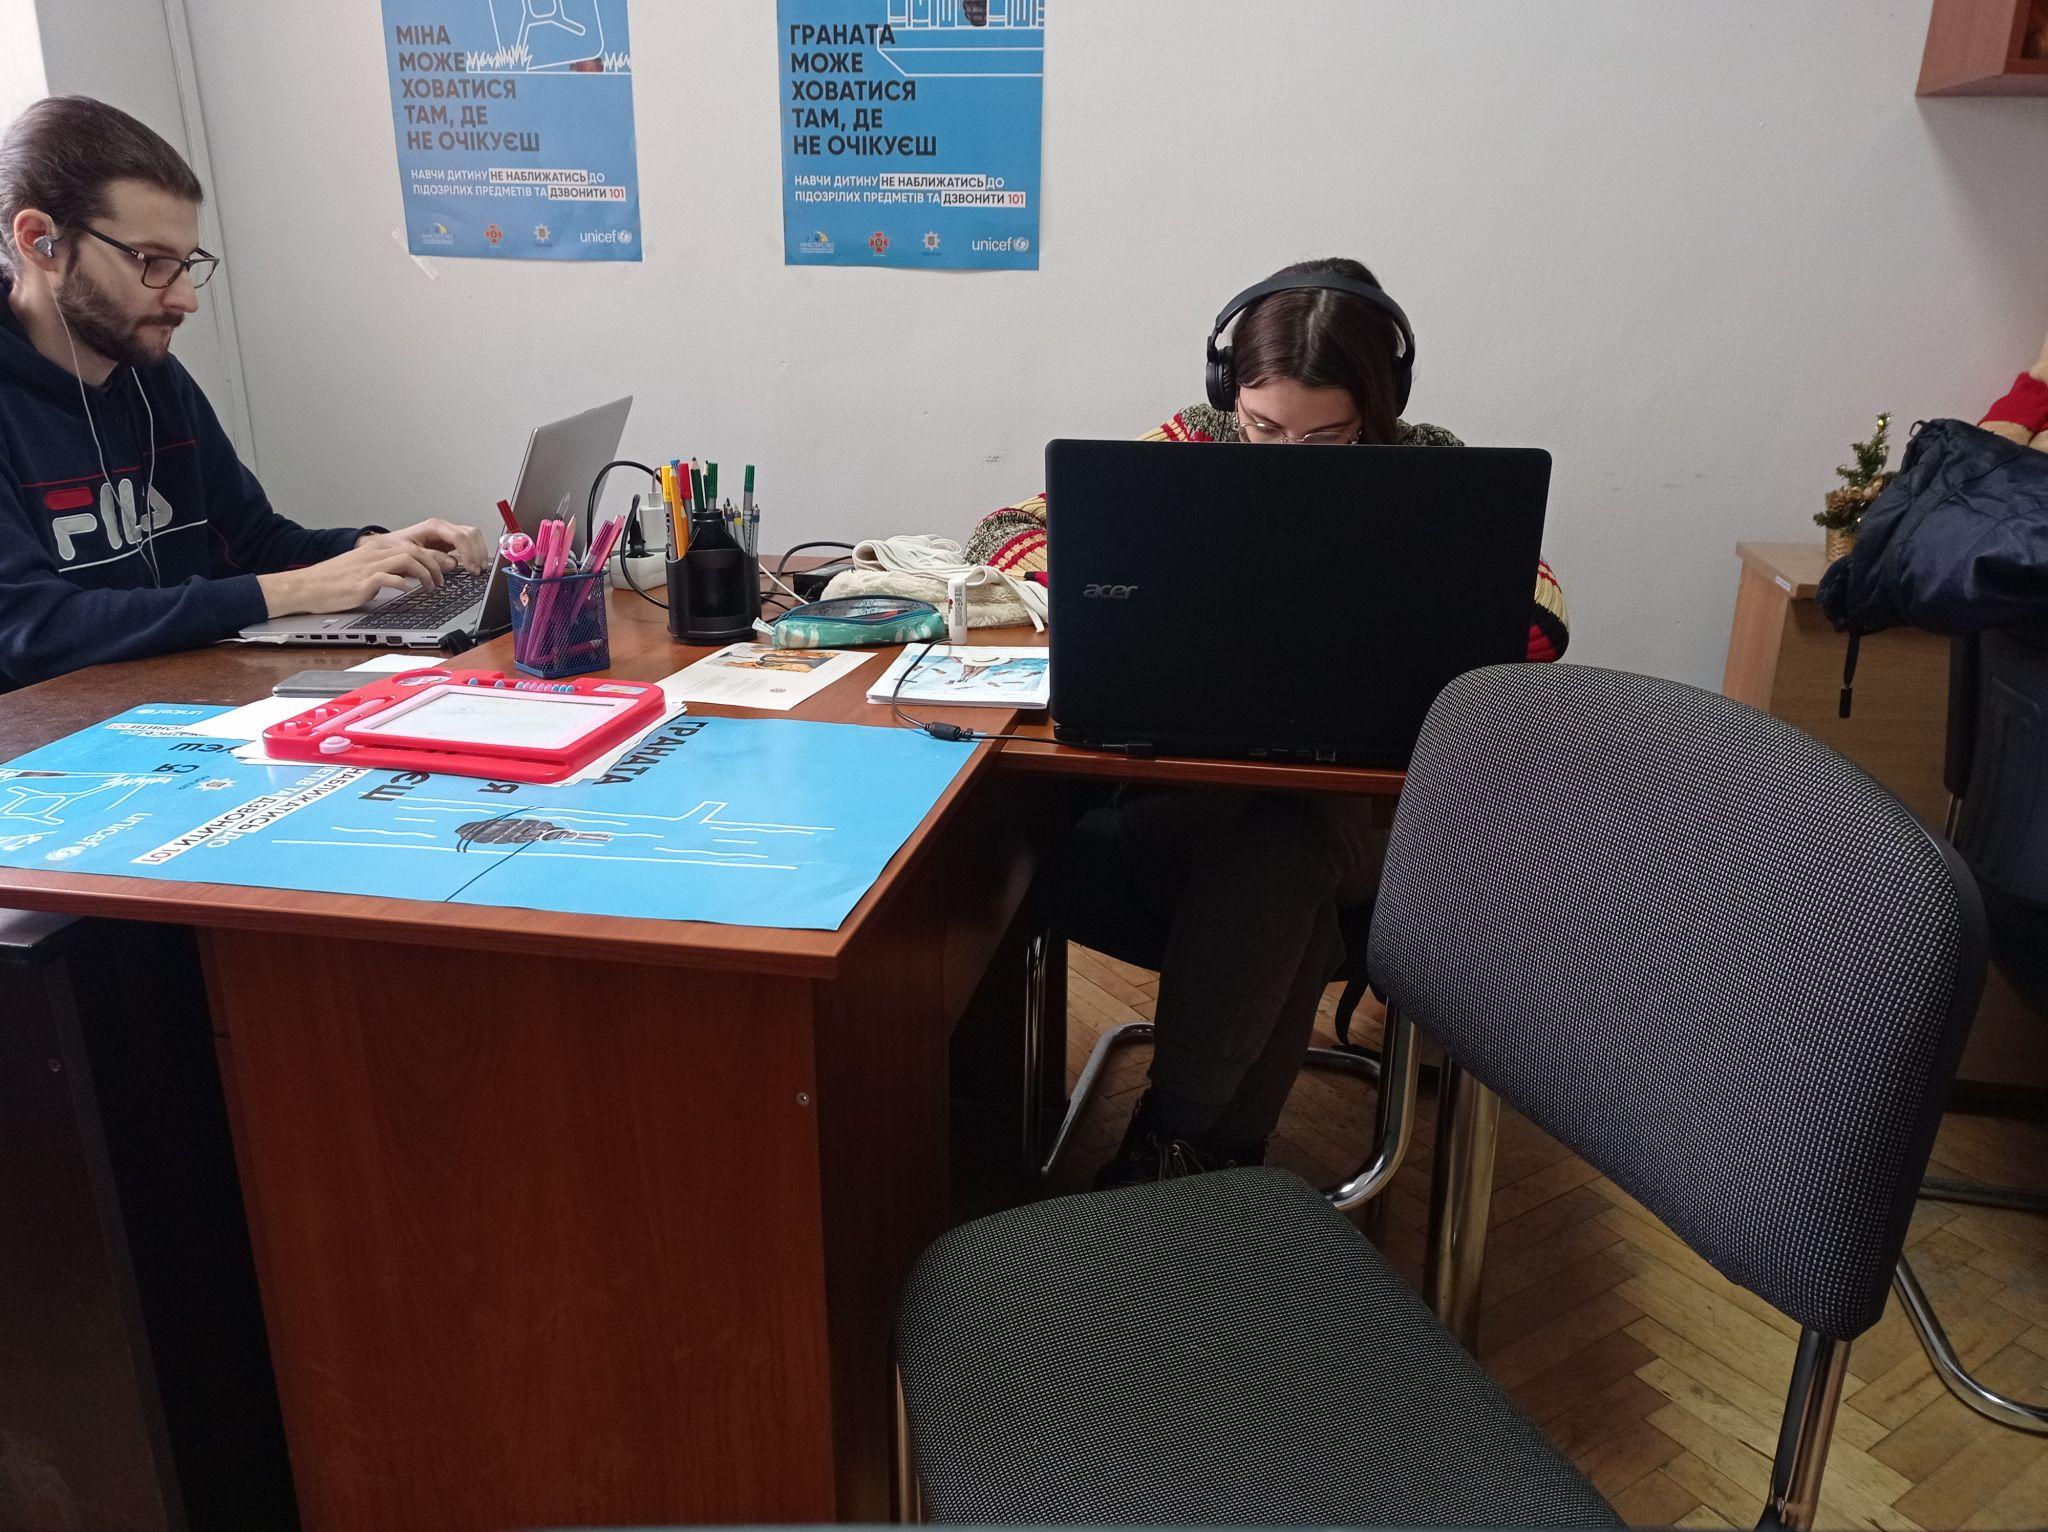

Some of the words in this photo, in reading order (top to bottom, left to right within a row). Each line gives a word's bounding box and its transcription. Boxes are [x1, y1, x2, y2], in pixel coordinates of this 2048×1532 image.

[396, 25, 451, 45] МІНА
[790, 24, 896, 45] ГРАНАТА
[399, 52, 467, 72] МОЖЕ
[791, 52, 864, 73] МОЖЕ
[401, 78, 517, 99] ХОВАТИСЯ
[791, 80, 916, 101] ХОВАТИСЯ
[404, 105, 454, 128] ТАМ,
[460, 105, 488, 128] ДЕ
[792, 108, 846, 132] ТАМ,
[853, 108, 883, 132] ДЕ
[407, 131, 433, 150] НЕ
[438, 131, 540, 152] ОЧІКУЄШ
[793, 135, 821, 155] НЕ
[827, 134, 937, 156] ОЧІКУЄШ
[411, 169, 446, 181] НАВЧИ
[447, 170, 488, 182] ДИТИНУ
[490, 171, 504, 181] НЕ
[506, 171, 587, 182] НАБЛИЖАТИСЬ
[588, 172, 605, 184] ДО
[794, 175, 831, 186] НАВЧИ
[834, 176, 878, 188] ДИТИНУ
[881, 176, 895, 187] НЕ
[898, 177, 984, 188] НАБЛИЖАТИСЬ
[986, 178, 1004, 189] ДО
[413, 185, 472, 196] ПІДОЗРІЛИХ
[475, 186, 532, 198] ПРЕДМЕТІВ
[533, 187, 547, 197] ТА
[550, 187, 607, 199] ДЗВОНИТИ
[609, 188, 625, 198] 101
[795, 191, 861, 204] ПІДОЗРІЛИХ
[863, 192, 923, 204] ПРЕДМЕТІВ
[925, 193, 941, 203] ТА
[943, 193, 1005, 205] ДЗВОНИТИ
[1007, 194, 1024, 205] 101
[580, 230, 617, 243] unicef
[971, 237, 1012, 251] unicef
[44, 478, 173, 560] FILA
[1082, 584, 1139, 599] acer
[591, 721, 710, 785] ГРАНАТА
[238, 767, 370, 830] НАБЛИЖАТИСЬ
[75, 812, 154, 848] unicef
[174, 796, 277, 847] ДЗВОНИТИ
[206, 831, 245, 849] ДО
[141, 842, 181, 863] 101
